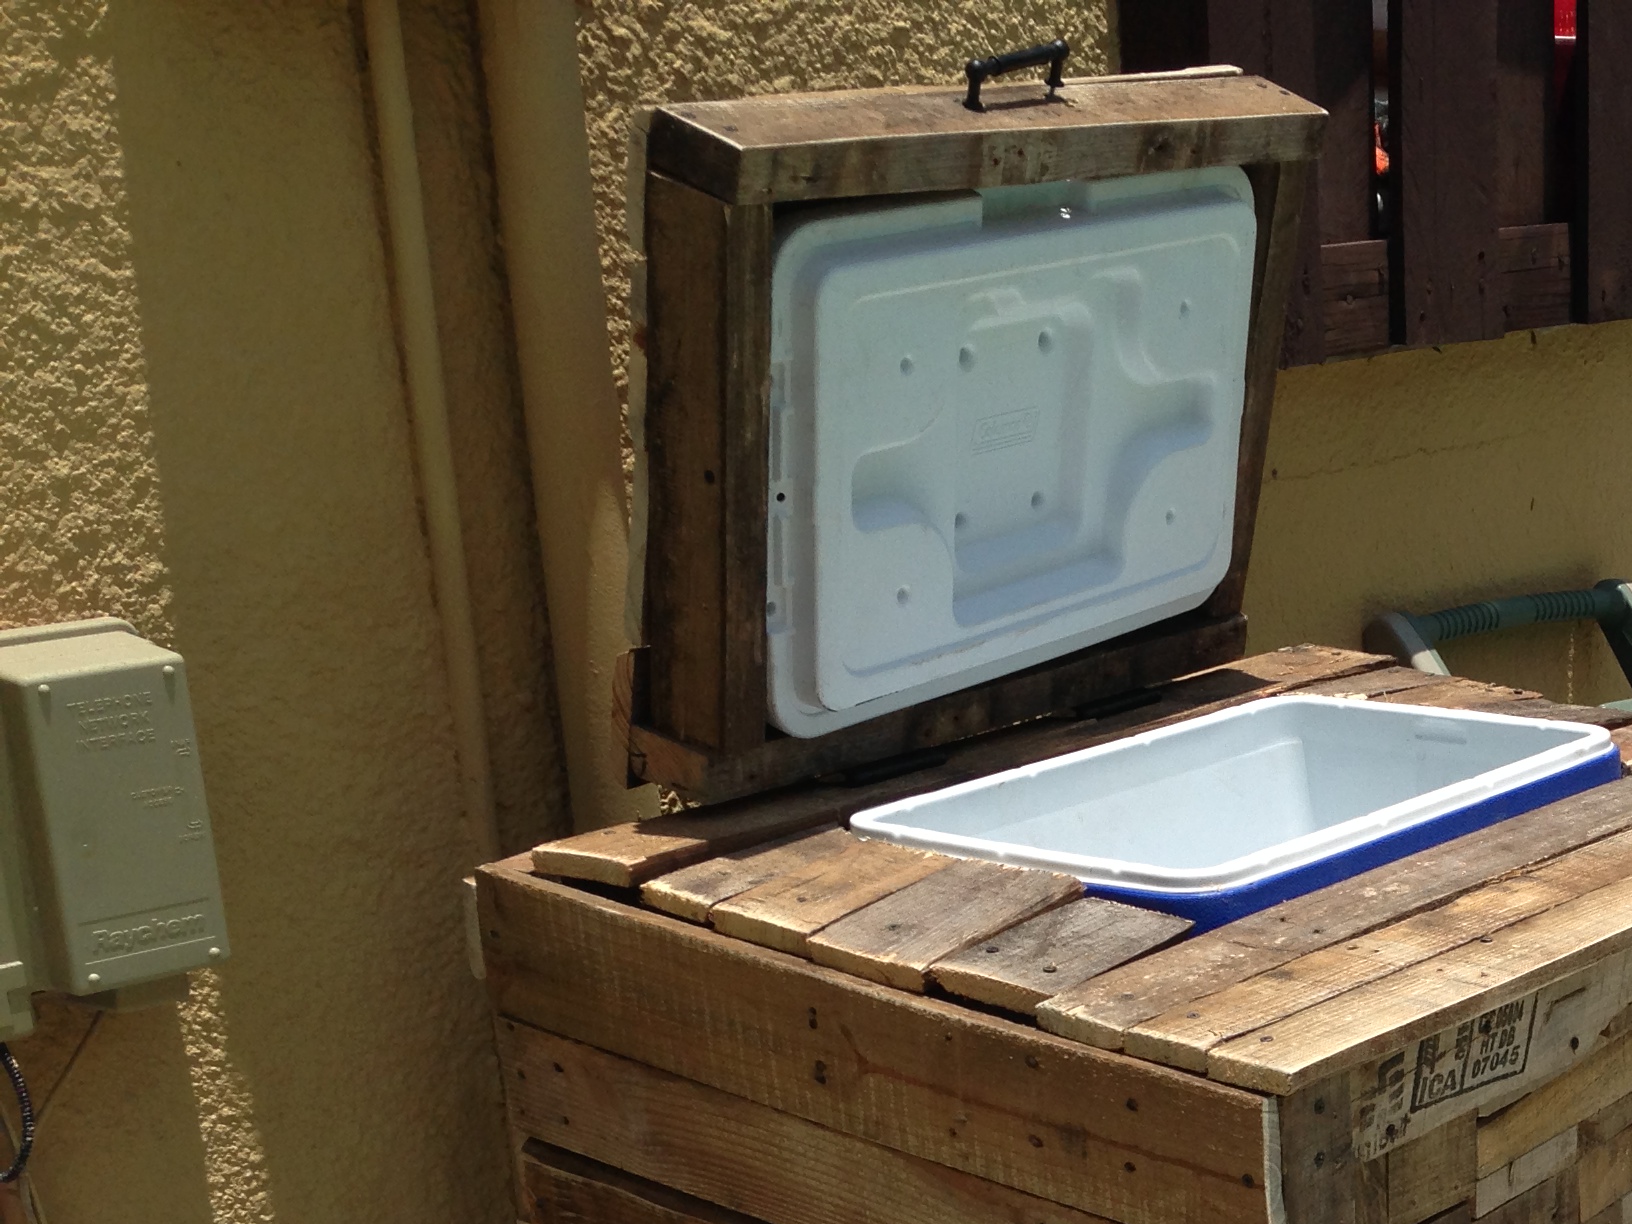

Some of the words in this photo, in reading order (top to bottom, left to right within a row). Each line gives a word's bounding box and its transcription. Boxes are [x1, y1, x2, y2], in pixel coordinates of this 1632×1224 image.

[66, 690, 153, 715] TELEPHONE
[78, 710, 151, 733] NETWORK
[76, 727, 157, 750] INTERFACE
[91, 912, 205, 956] Raychem
[1418, 1069, 1457, 1106] ICA
